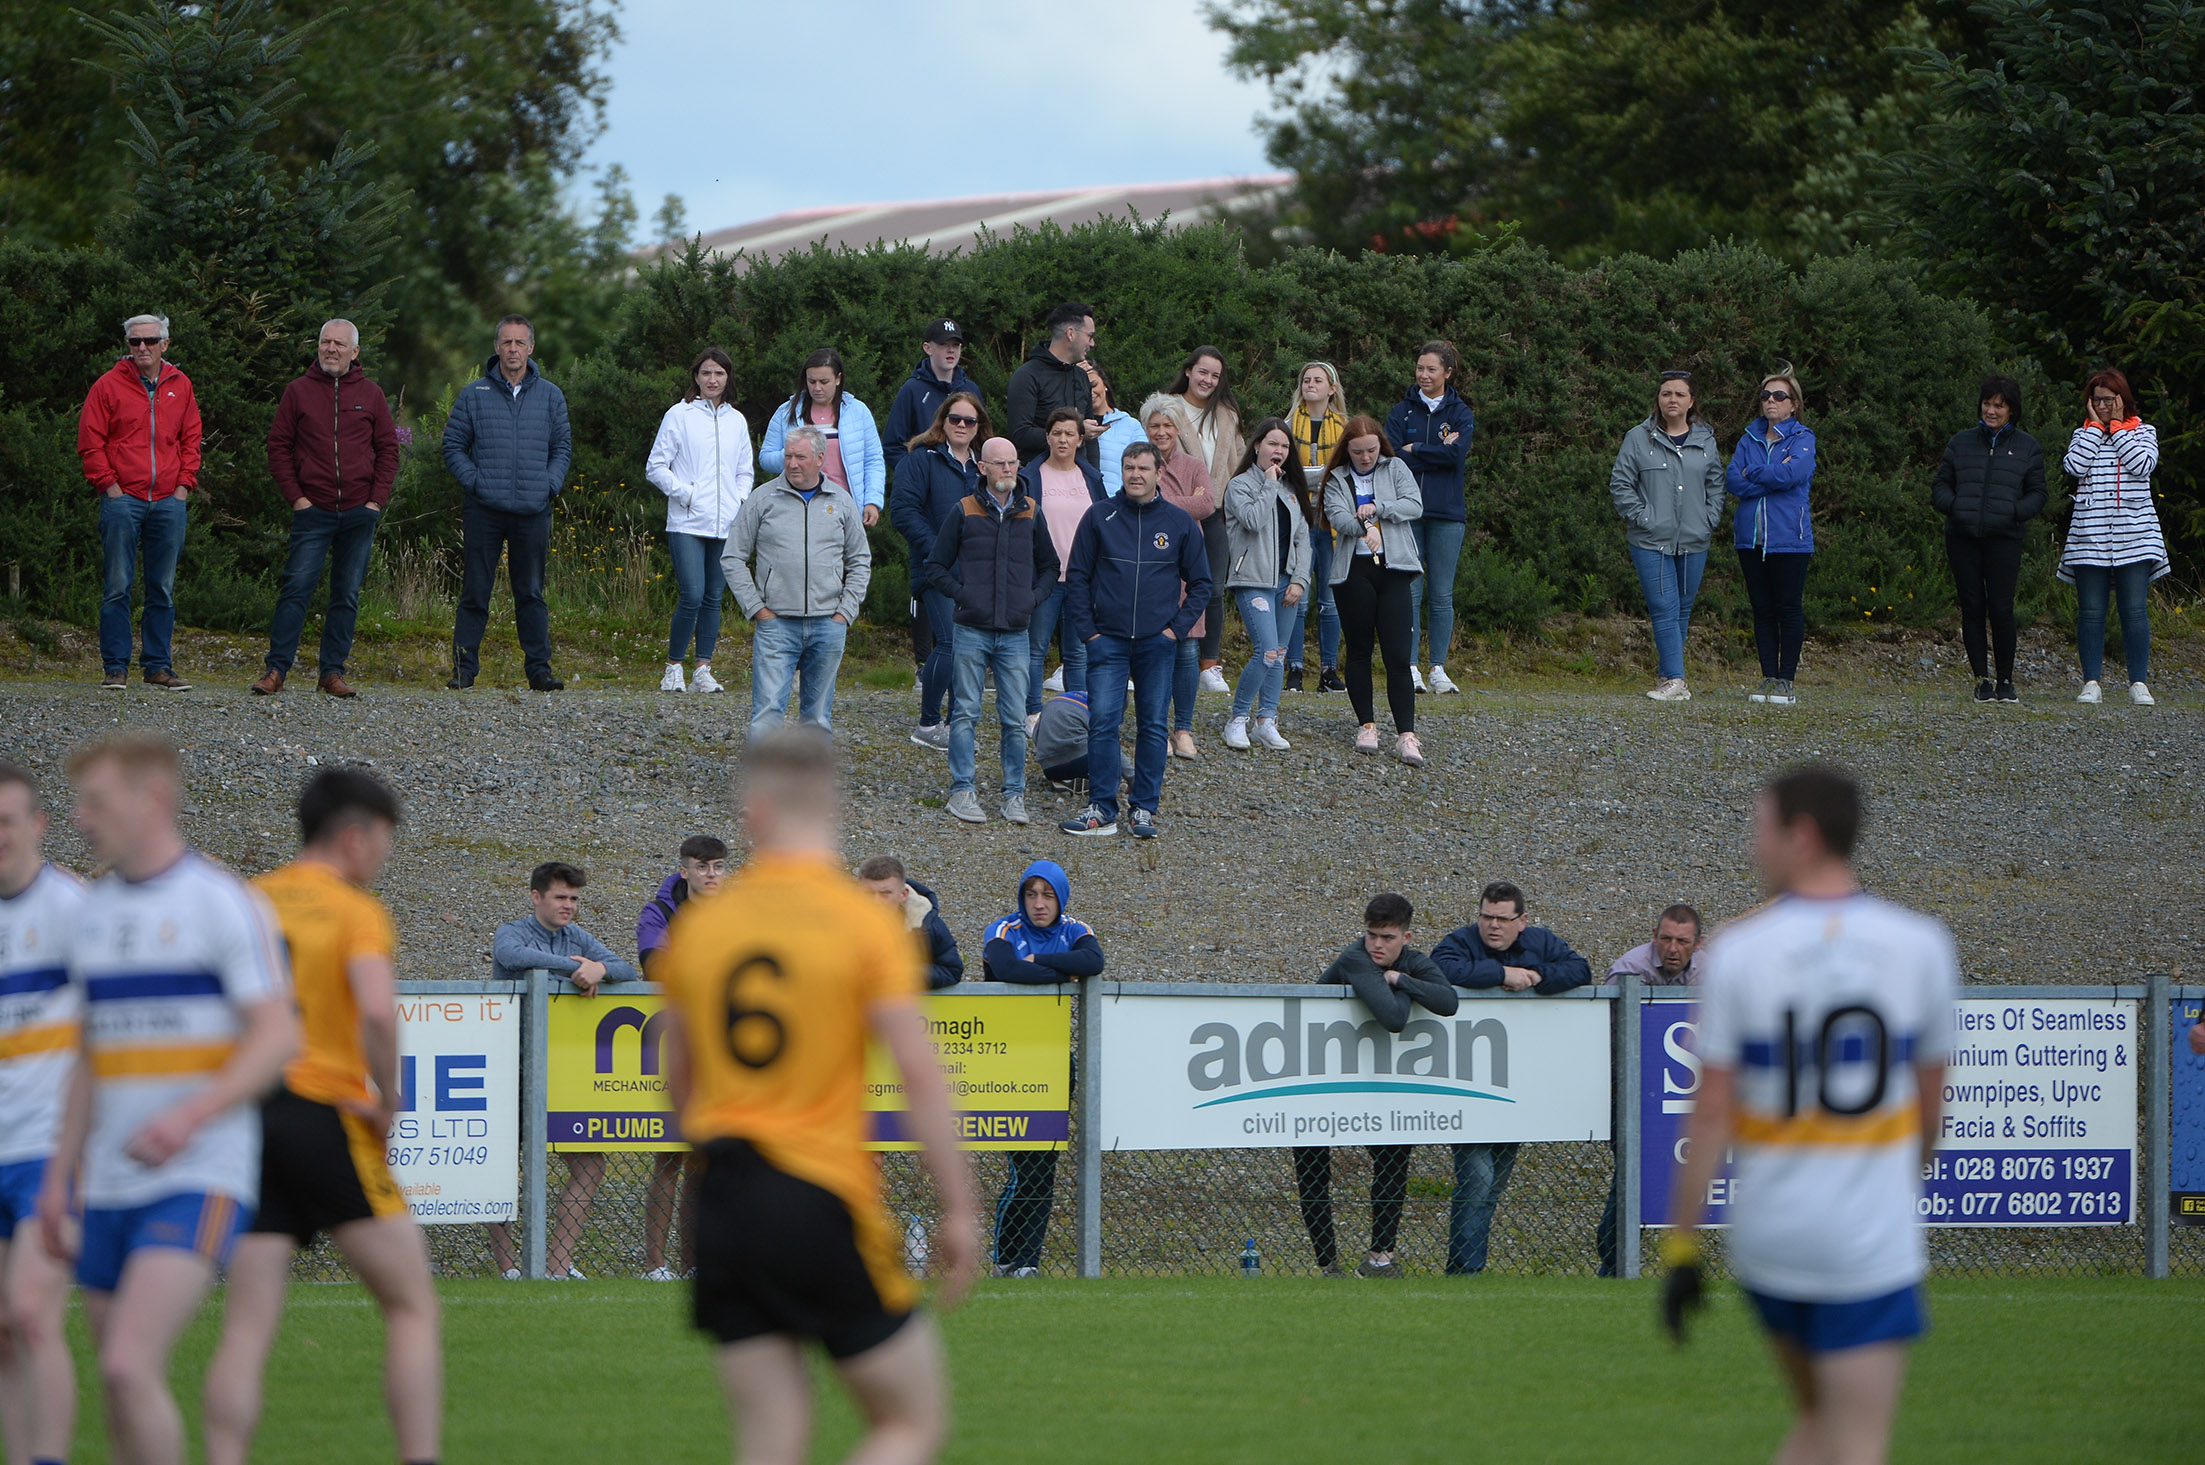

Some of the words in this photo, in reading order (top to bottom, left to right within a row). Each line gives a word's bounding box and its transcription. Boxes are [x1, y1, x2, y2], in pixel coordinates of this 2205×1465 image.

[395, 996, 464, 1022] wire
[480, 995, 503, 1022] it
[725, 953, 788, 1070] 6
[2002, 1007, 2026, 1031] Of
[2031, 1007, 2127, 1031] Seamless
[943, 1042, 974, 1055] 2334
[977, 1042, 1007, 1055] 3712
[1187, 998, 1509, 1092] adman
[935, 1061, 967, 1075] mail:
[1784, 1003, 1887, 1118] 10
[2015, 1043, 2108, 1072] Guttering
[2114, 1044, 2128, 1067] &
[2052, 1079, 2102, 1108] Upvc
[432, 1119, 488, 1138] LTD
[588, 1117, 665, 1139] PLUMB
[1242, 1112, 1286, 1135] civil
[1293, 1112, 1383, 1139] projects
[1390, 1110, 1463, 1133] limited
[1941, 1115, 1995, 1138] Facia
[2002, 1115, 2016, 1138] &
[2023, 1115, 2087, 1138] Soffits
[386, 1147, 424, 1167] 867
[429, 1146, 488, 1166] 51049
[1954, 1157, 1996, 1180] 028
[2001, 1157, 2056, 1180] 8076
[2061, 1157, 2115, 1180] 1937
[399, 1182, 442, 1197] vailable
[404, 1199, 513, 1217] ndelectrics.com
[1961, 1192, 2003, 1215] 077
[2007, 1192, 2062, 1215] 6802
[2067, 1192, 2122, 1215] 7613
